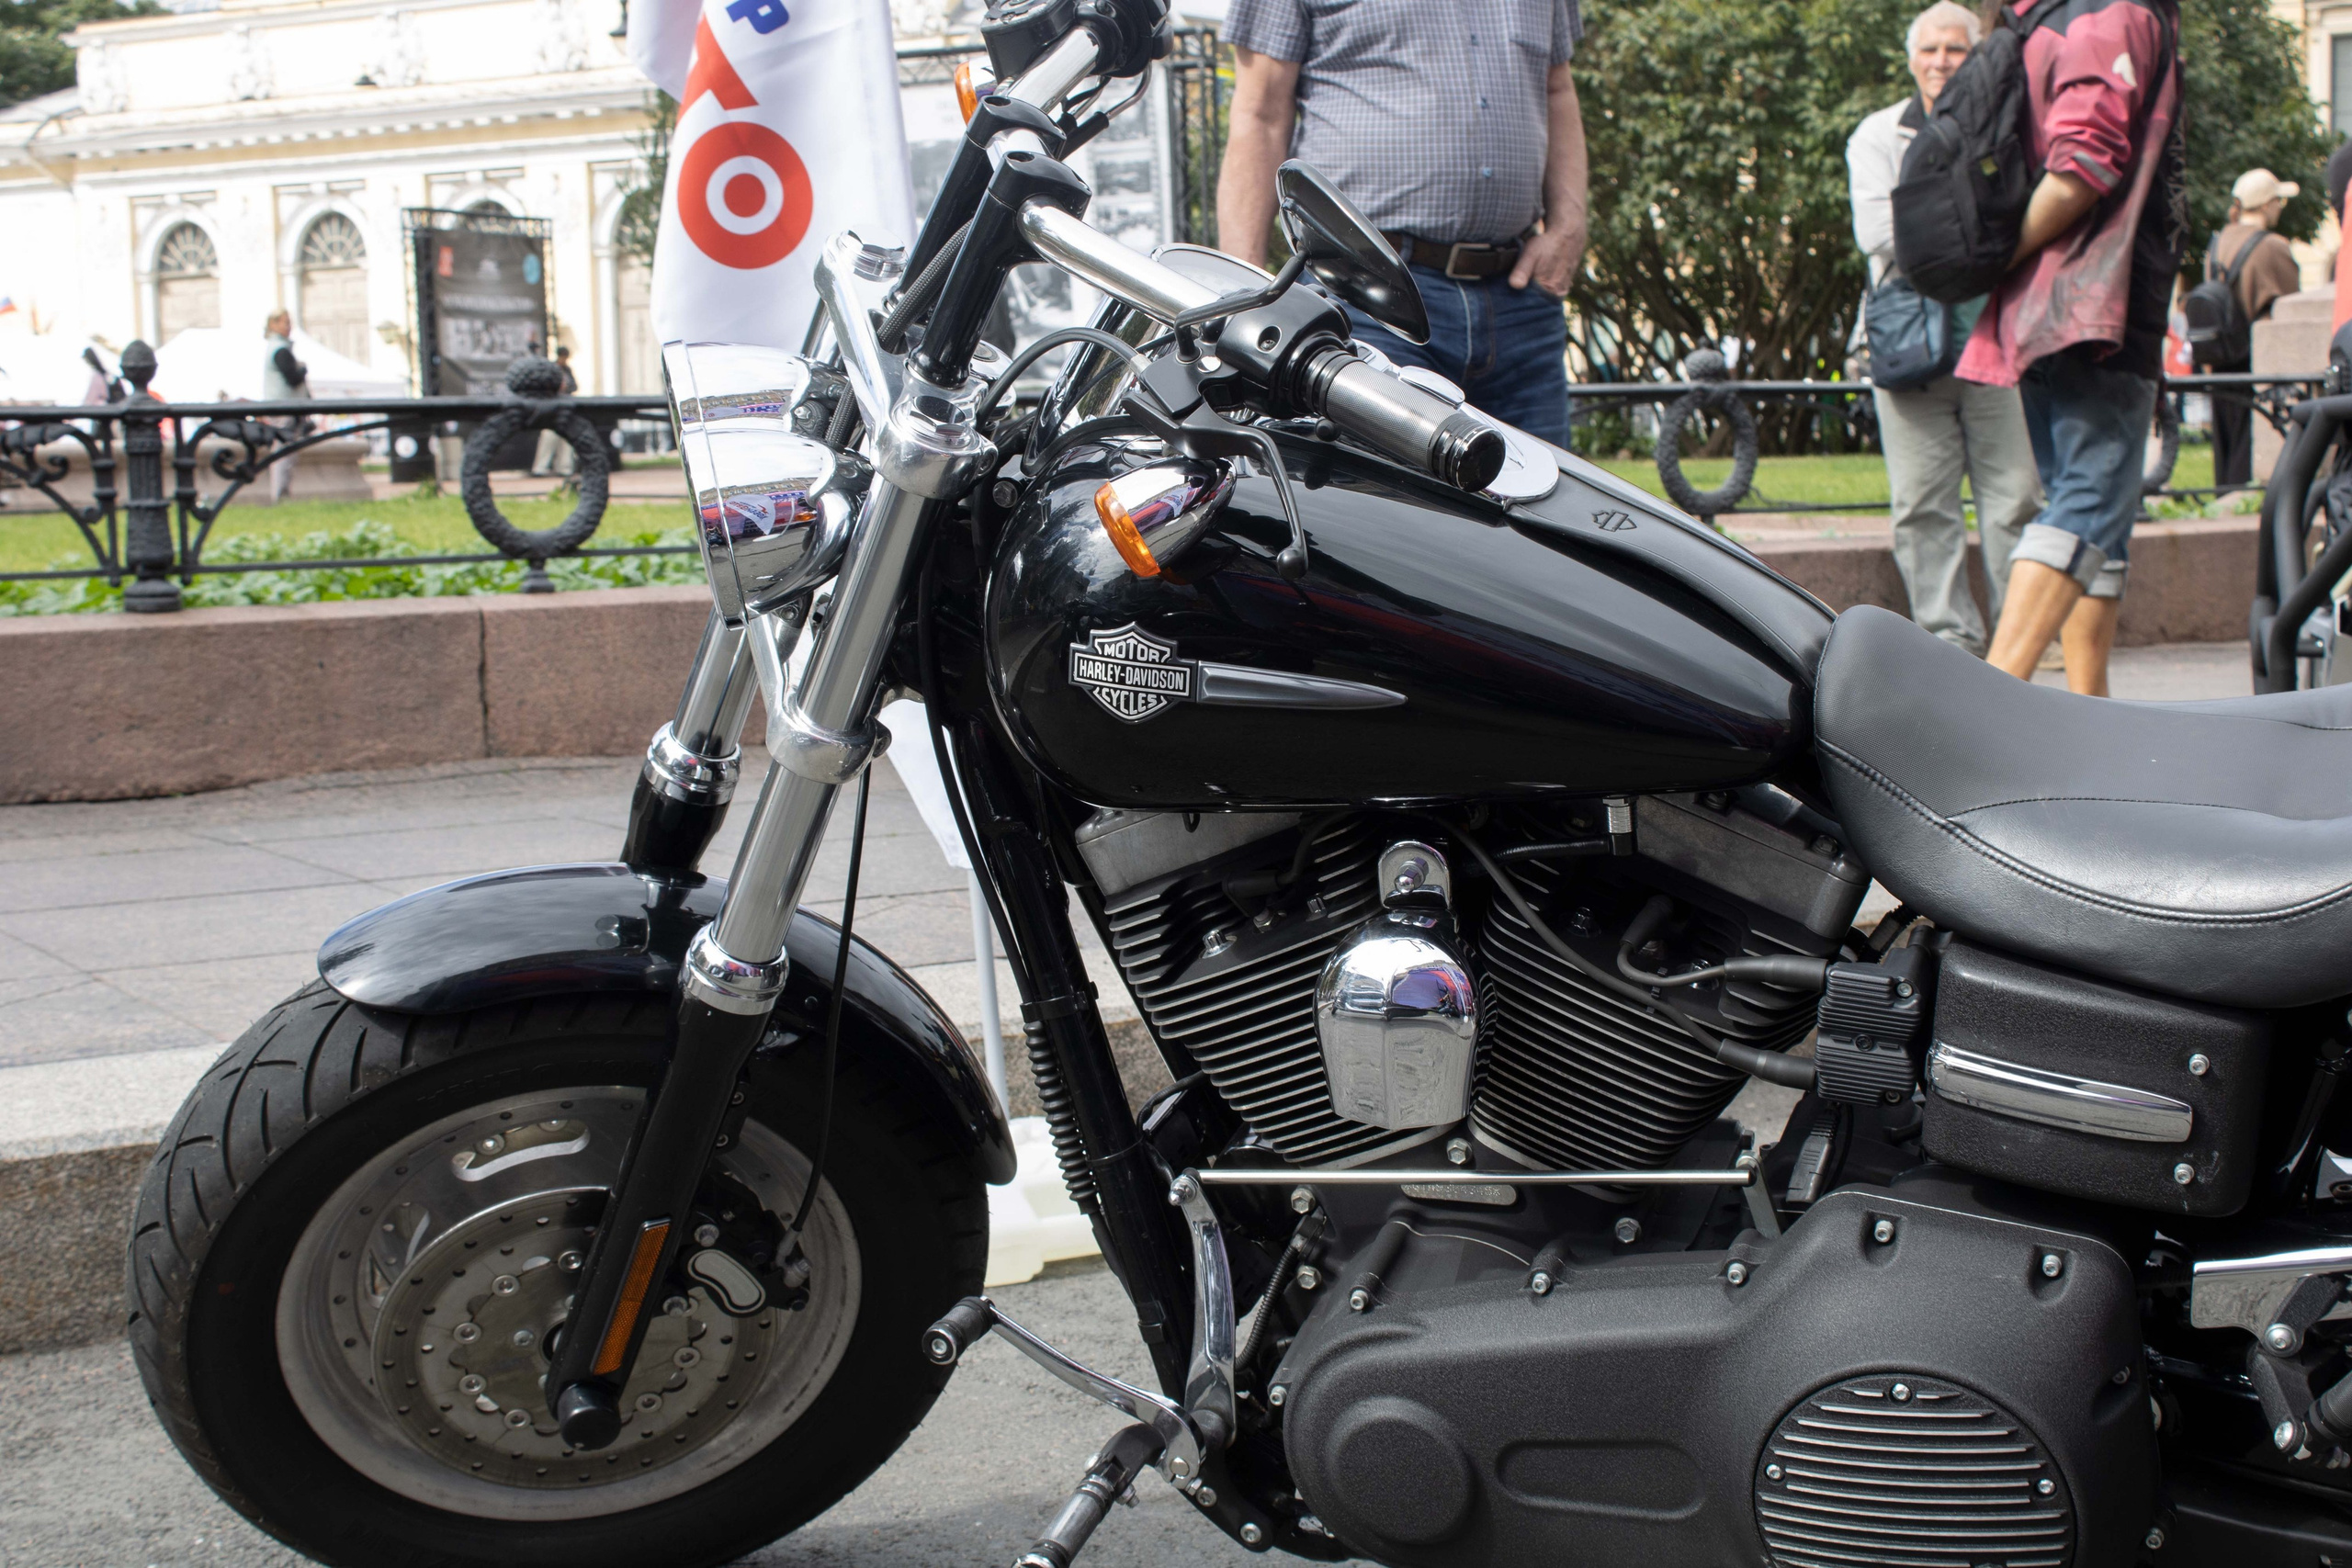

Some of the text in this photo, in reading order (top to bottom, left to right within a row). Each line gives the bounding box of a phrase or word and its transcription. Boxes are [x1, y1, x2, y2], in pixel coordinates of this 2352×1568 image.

[1103, 637, 1159, 662] MOTOR
[1079, 659, 1184, 690] HARLEY-DAVIDSON
[1102, 687, 1158, 715] CYCLES
